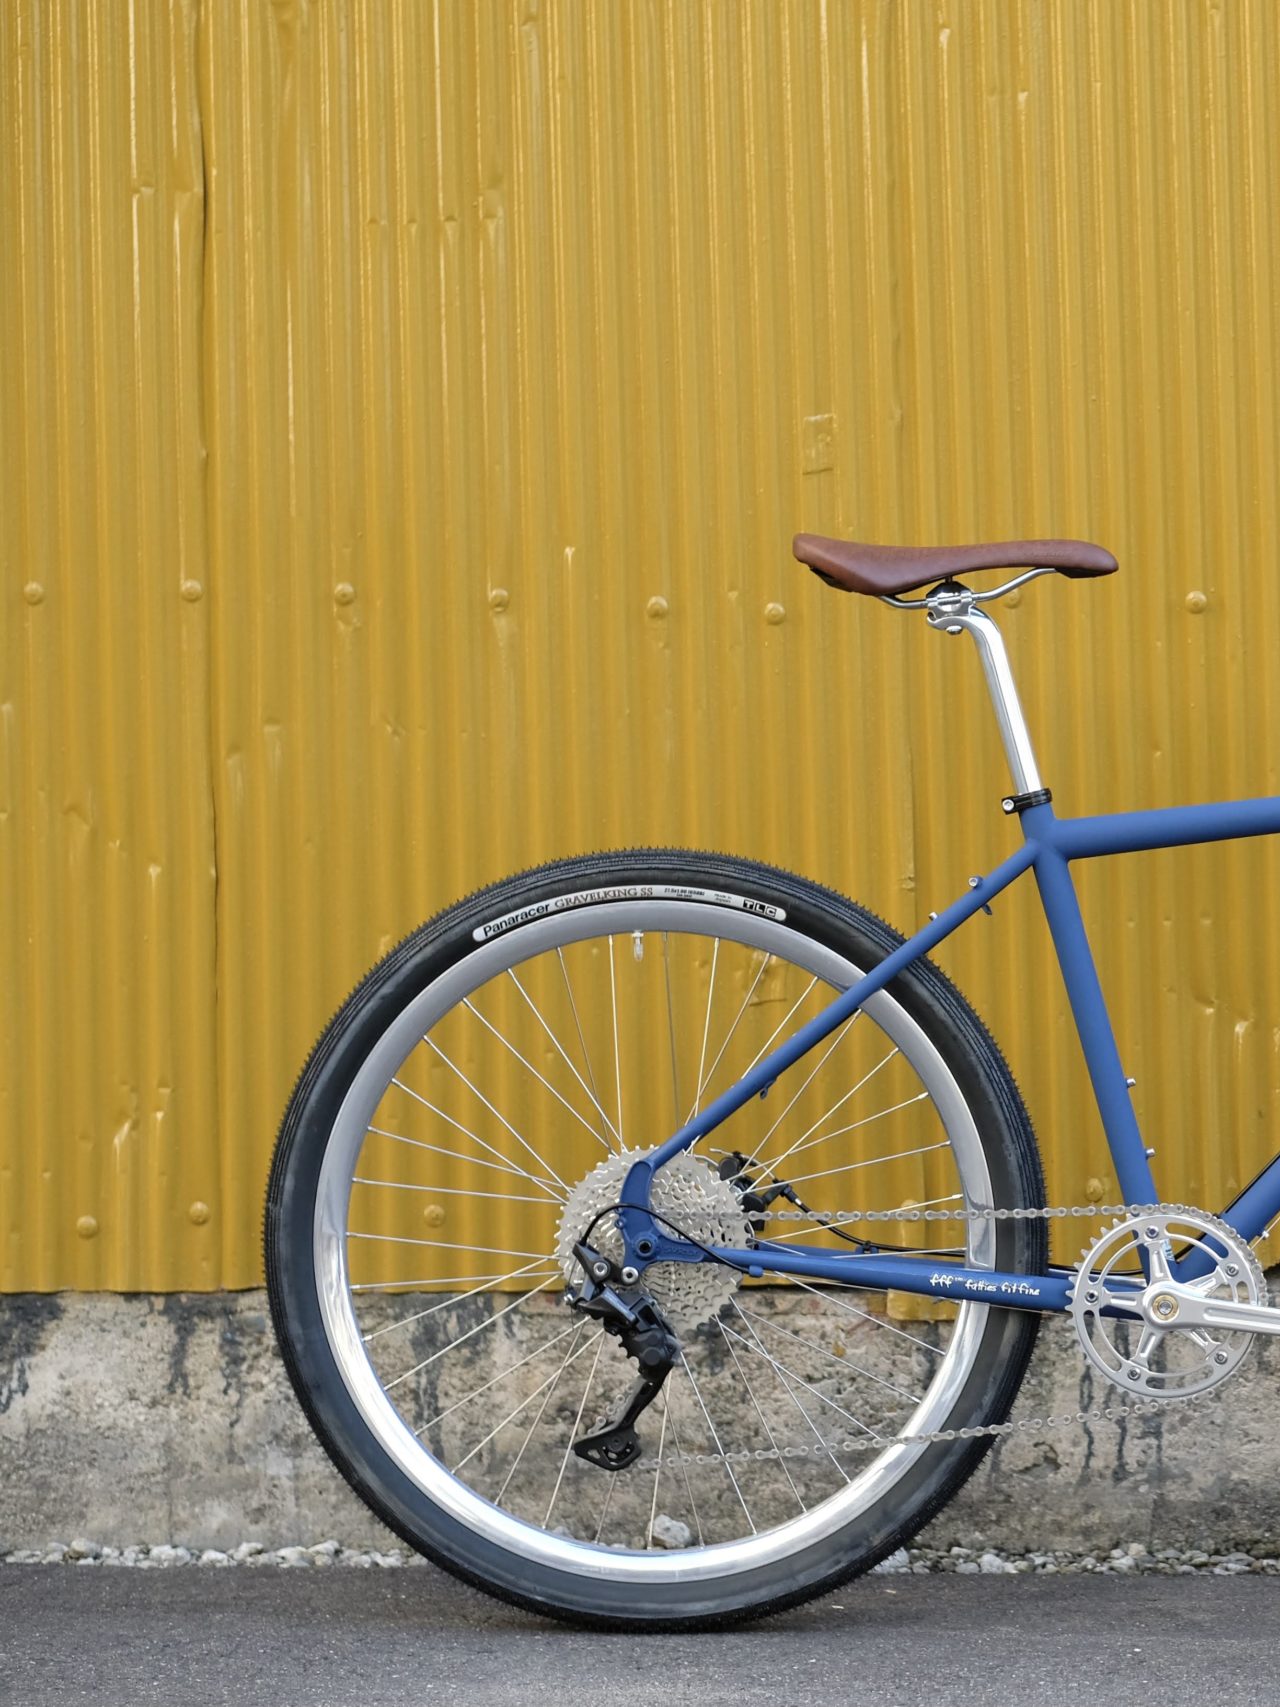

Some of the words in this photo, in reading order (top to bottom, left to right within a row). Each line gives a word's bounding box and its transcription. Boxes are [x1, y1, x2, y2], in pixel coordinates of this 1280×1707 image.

[482, 904, 550, 938] Panaracer
[554, 887, 638, 910] GRAVELKING
[640, 887, 653, 897] SS
[743, 899, 777, 918] TLC
[965, 1279, 997, 1292] fatties
[1001, 1282, 1017, 1294] fit
[1018, 1282, 1041, 1296] fine
